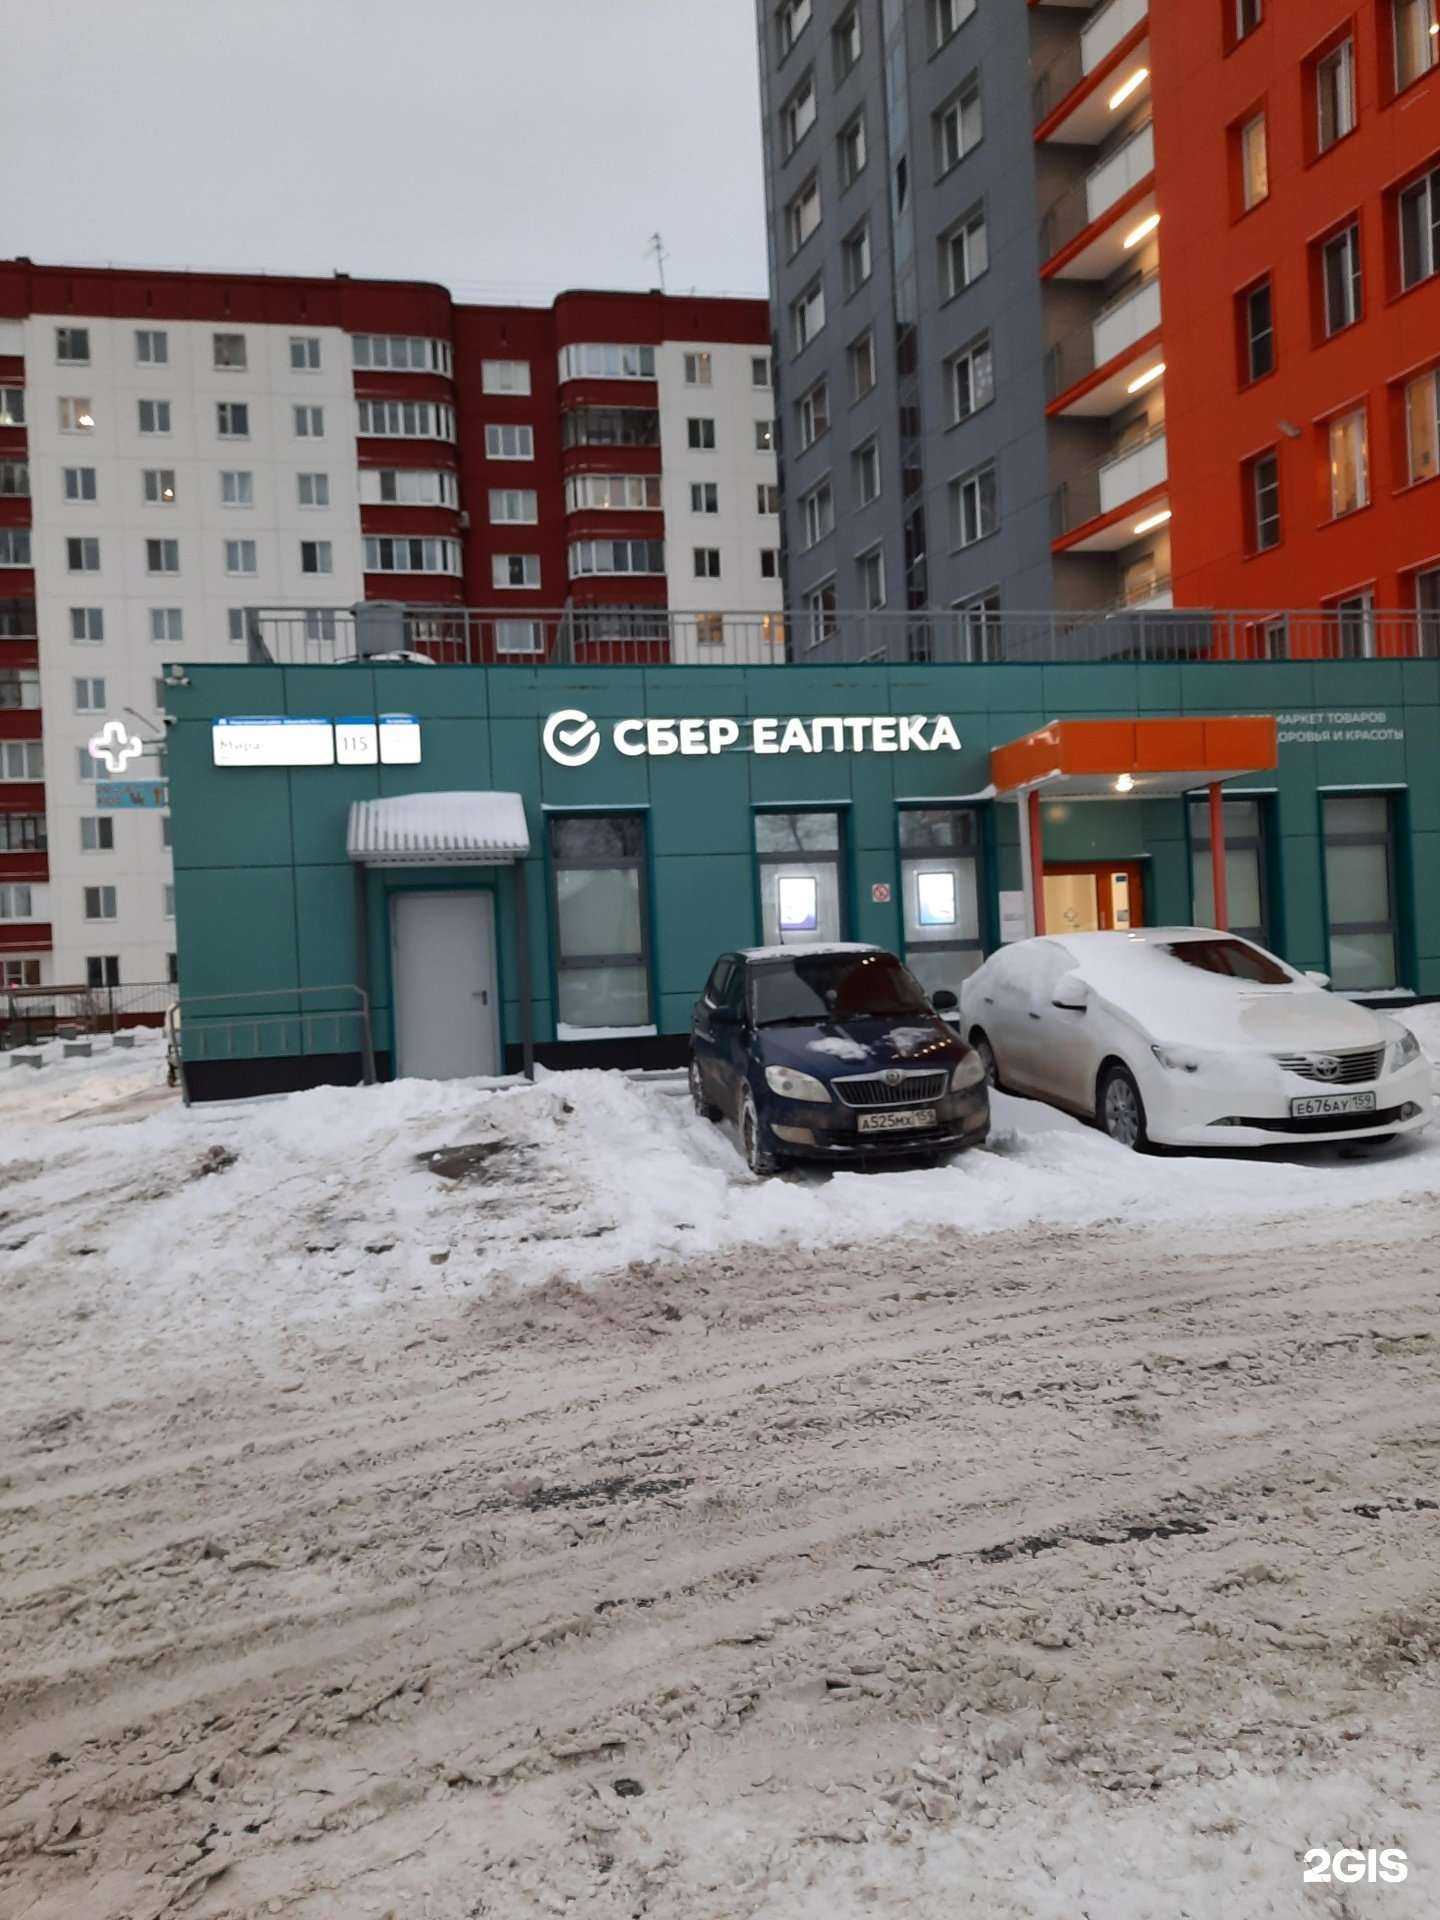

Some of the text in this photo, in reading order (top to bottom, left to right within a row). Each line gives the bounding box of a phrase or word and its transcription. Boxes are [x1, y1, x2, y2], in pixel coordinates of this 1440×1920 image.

[1327, 711, 1387, 724] ТОВАРОВ
[612, 714, 962, 756] СБЕР ЕАПТЕКА
[1333, 730, 1343, 741] И
[1345, 728, 1404, 741] КРАСОТЫ
[343, 736, 369, 752] 115
